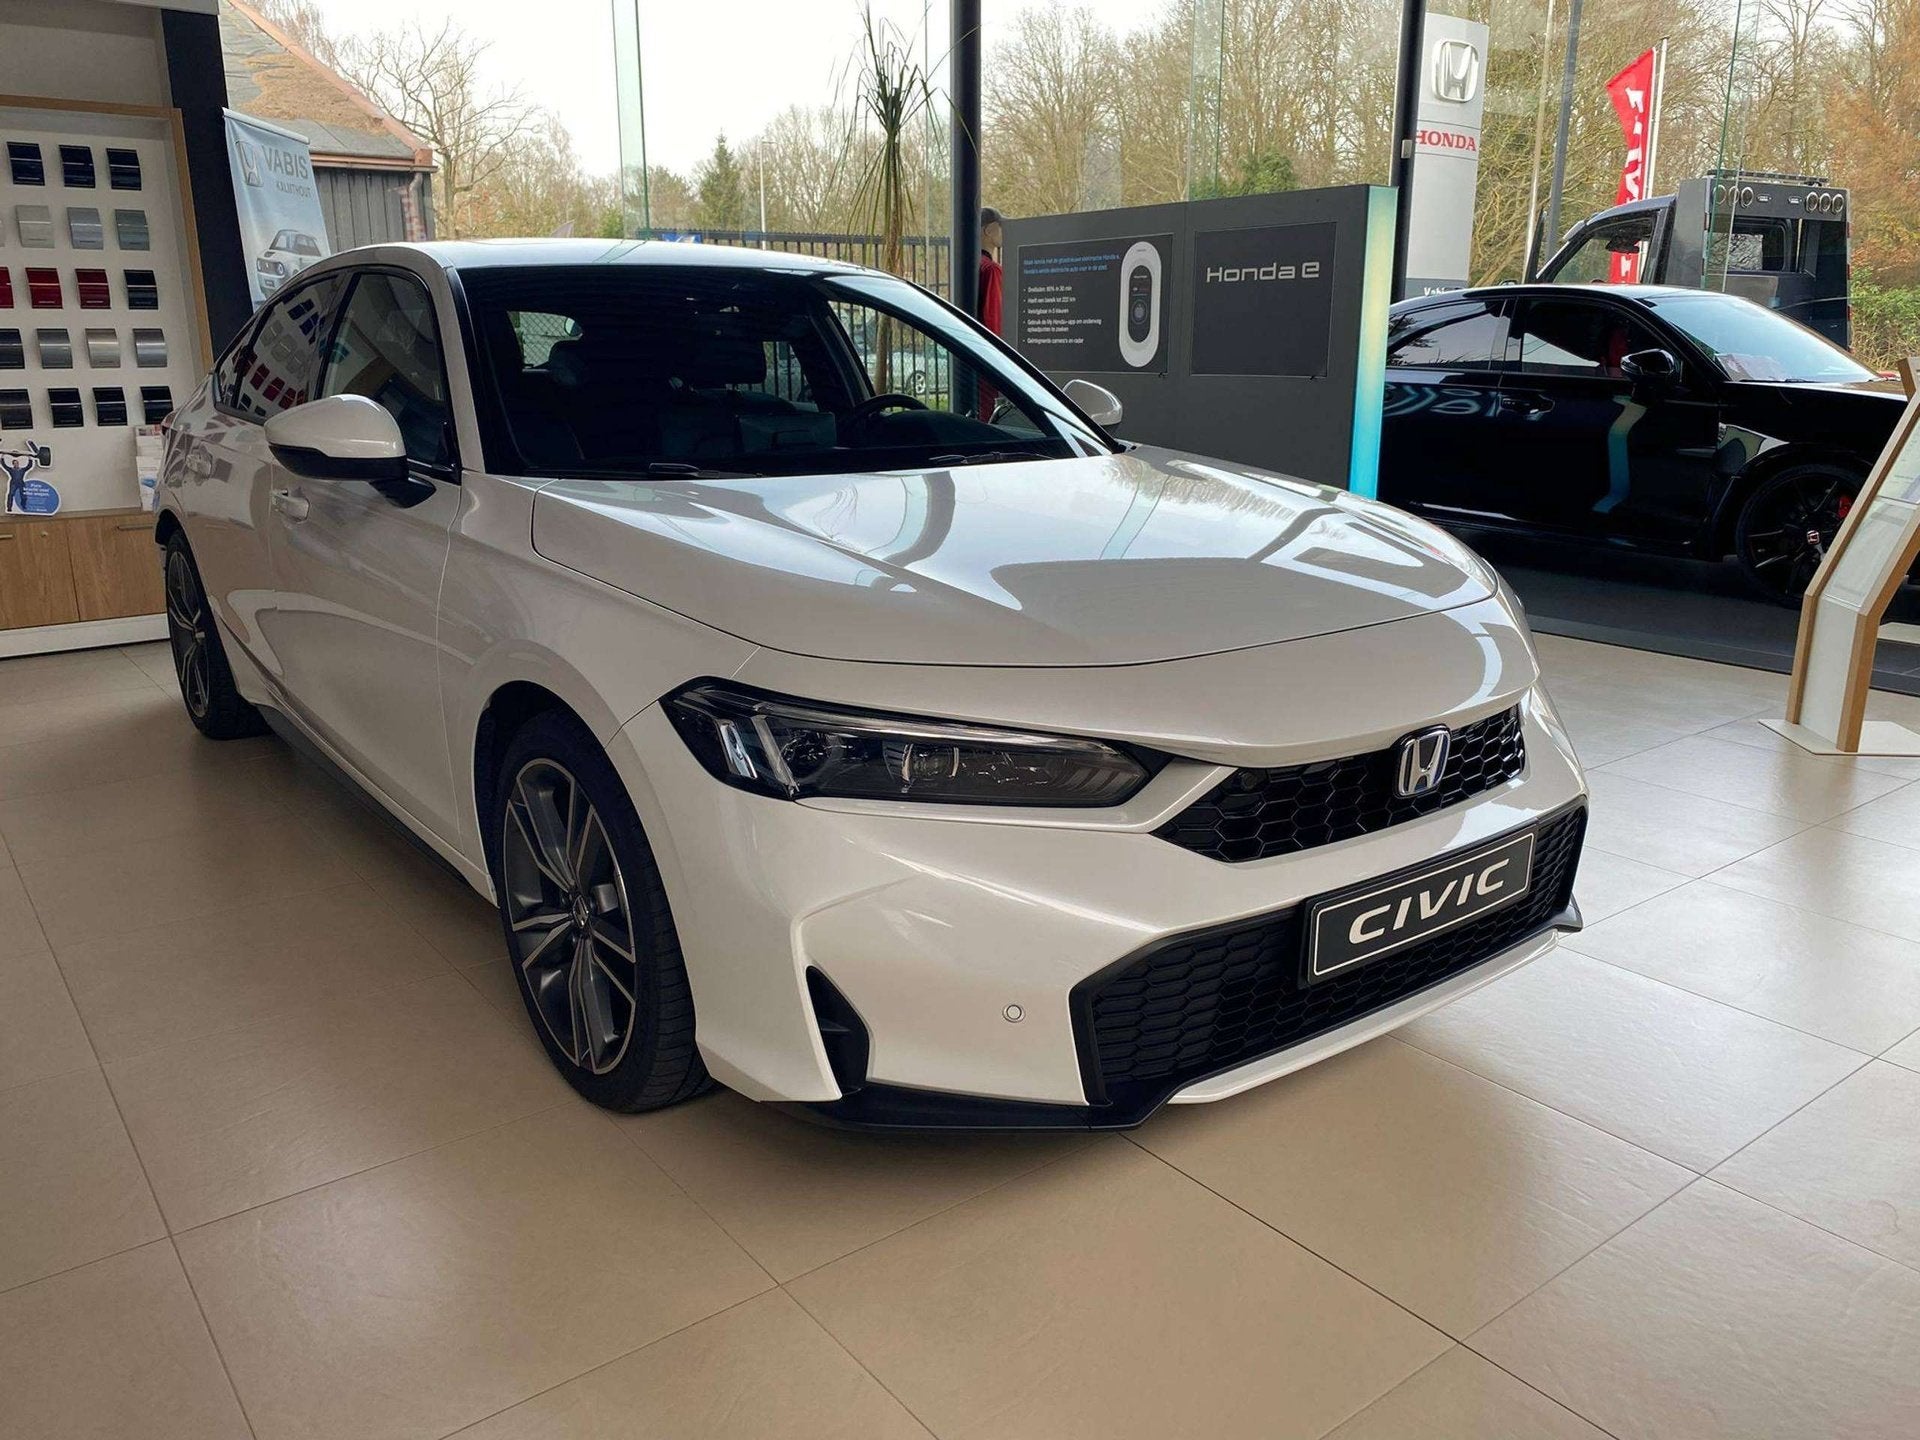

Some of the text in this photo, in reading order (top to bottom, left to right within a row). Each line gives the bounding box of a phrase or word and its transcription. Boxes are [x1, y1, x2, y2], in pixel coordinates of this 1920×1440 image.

[1415, 129, 1477, 152] HONDA
[261, 143, 309, 180] VABIS
[1206, 262, 1296, 282] Honda
[1349, 858, 1510, 945] CIVIC
